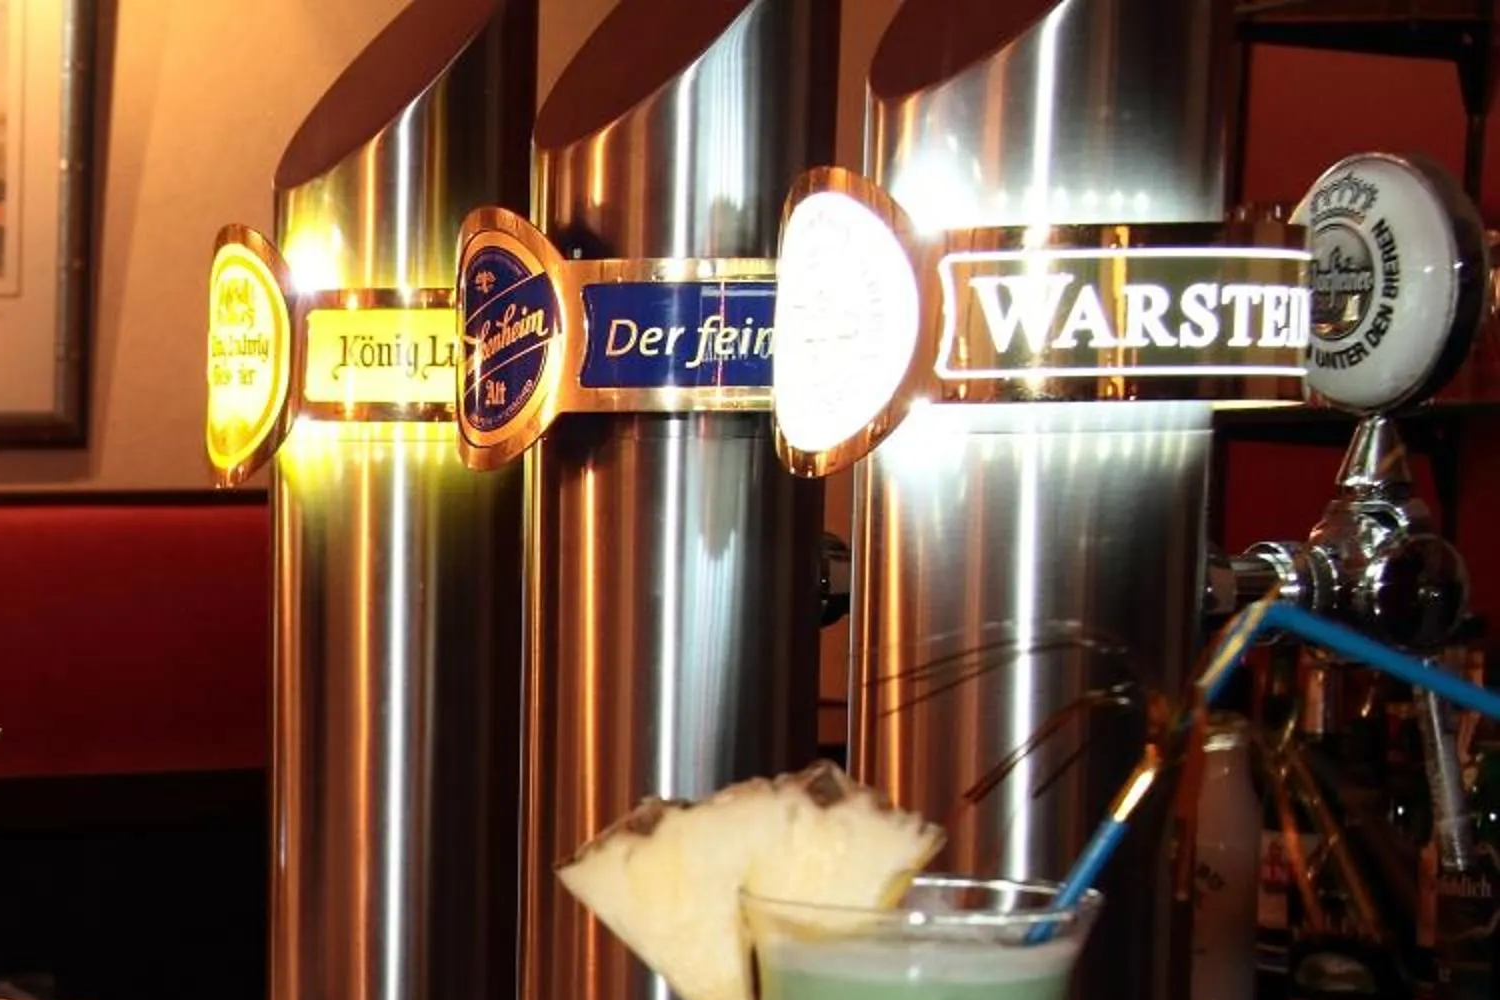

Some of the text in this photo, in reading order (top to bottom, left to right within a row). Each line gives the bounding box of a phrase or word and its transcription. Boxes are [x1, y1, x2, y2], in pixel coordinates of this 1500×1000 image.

[1315, 217, 1401, 369] UNTER DEN BIEREN
[331, 333, 419, 380] König
[605, 318, 685, 357] Der
